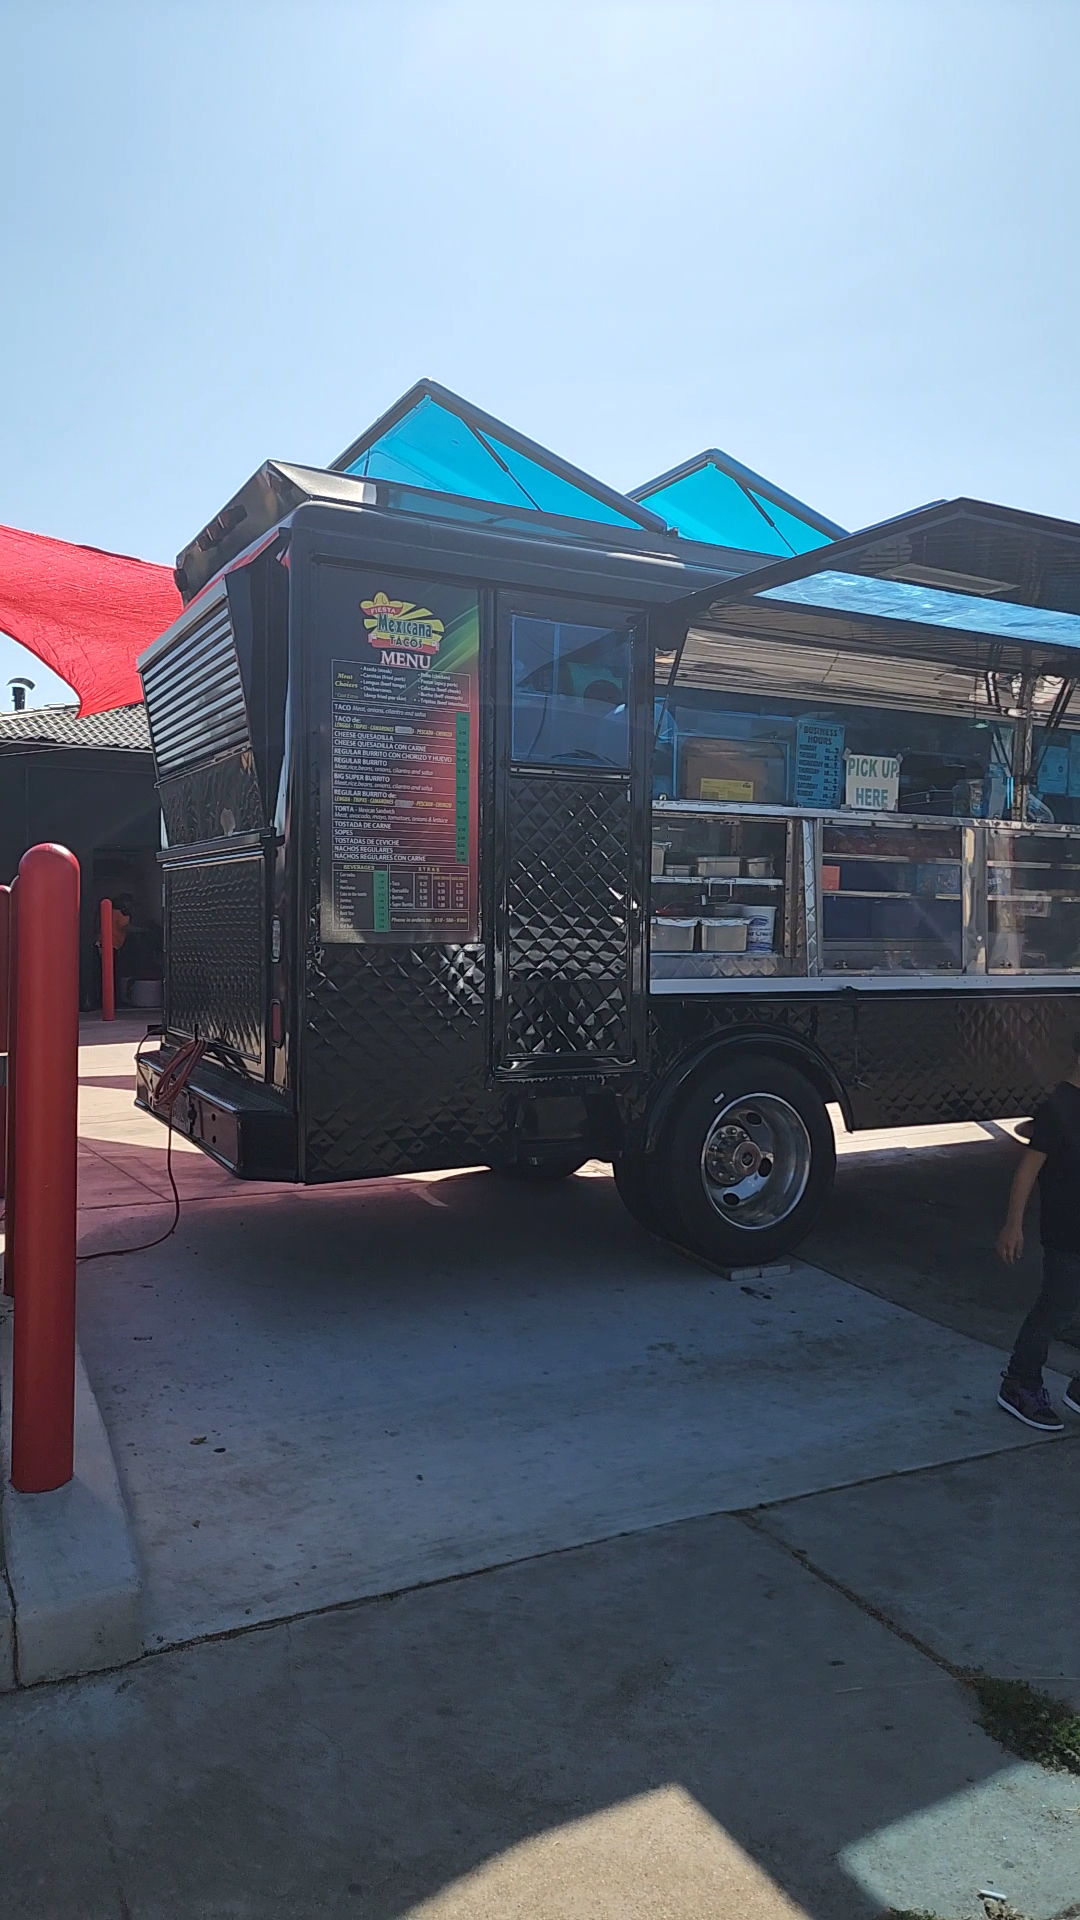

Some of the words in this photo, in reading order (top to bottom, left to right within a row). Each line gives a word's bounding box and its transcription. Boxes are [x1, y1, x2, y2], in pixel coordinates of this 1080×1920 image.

[377, 614, 432, 638] Mexicana
[390, 636, 423, 649] TACOS
[380, 651, 431, 668] MENU
[335, 680, 358, 688] Choices
[334, 730, 357, 738] CHEESE
[358, 733, 394, 741] QUESADILLA
[804, 726, 838, 736] BUSINESS
[358, 741, 394, 750] QUESADILLA
[808, 736, 832, 745] HOURS
[334, 756, 361, 764] REGULAR
[848, 758, 878, 778] PICK
[882, 760, 898, 778] UP
[856, 788, 888, 807] HERE
